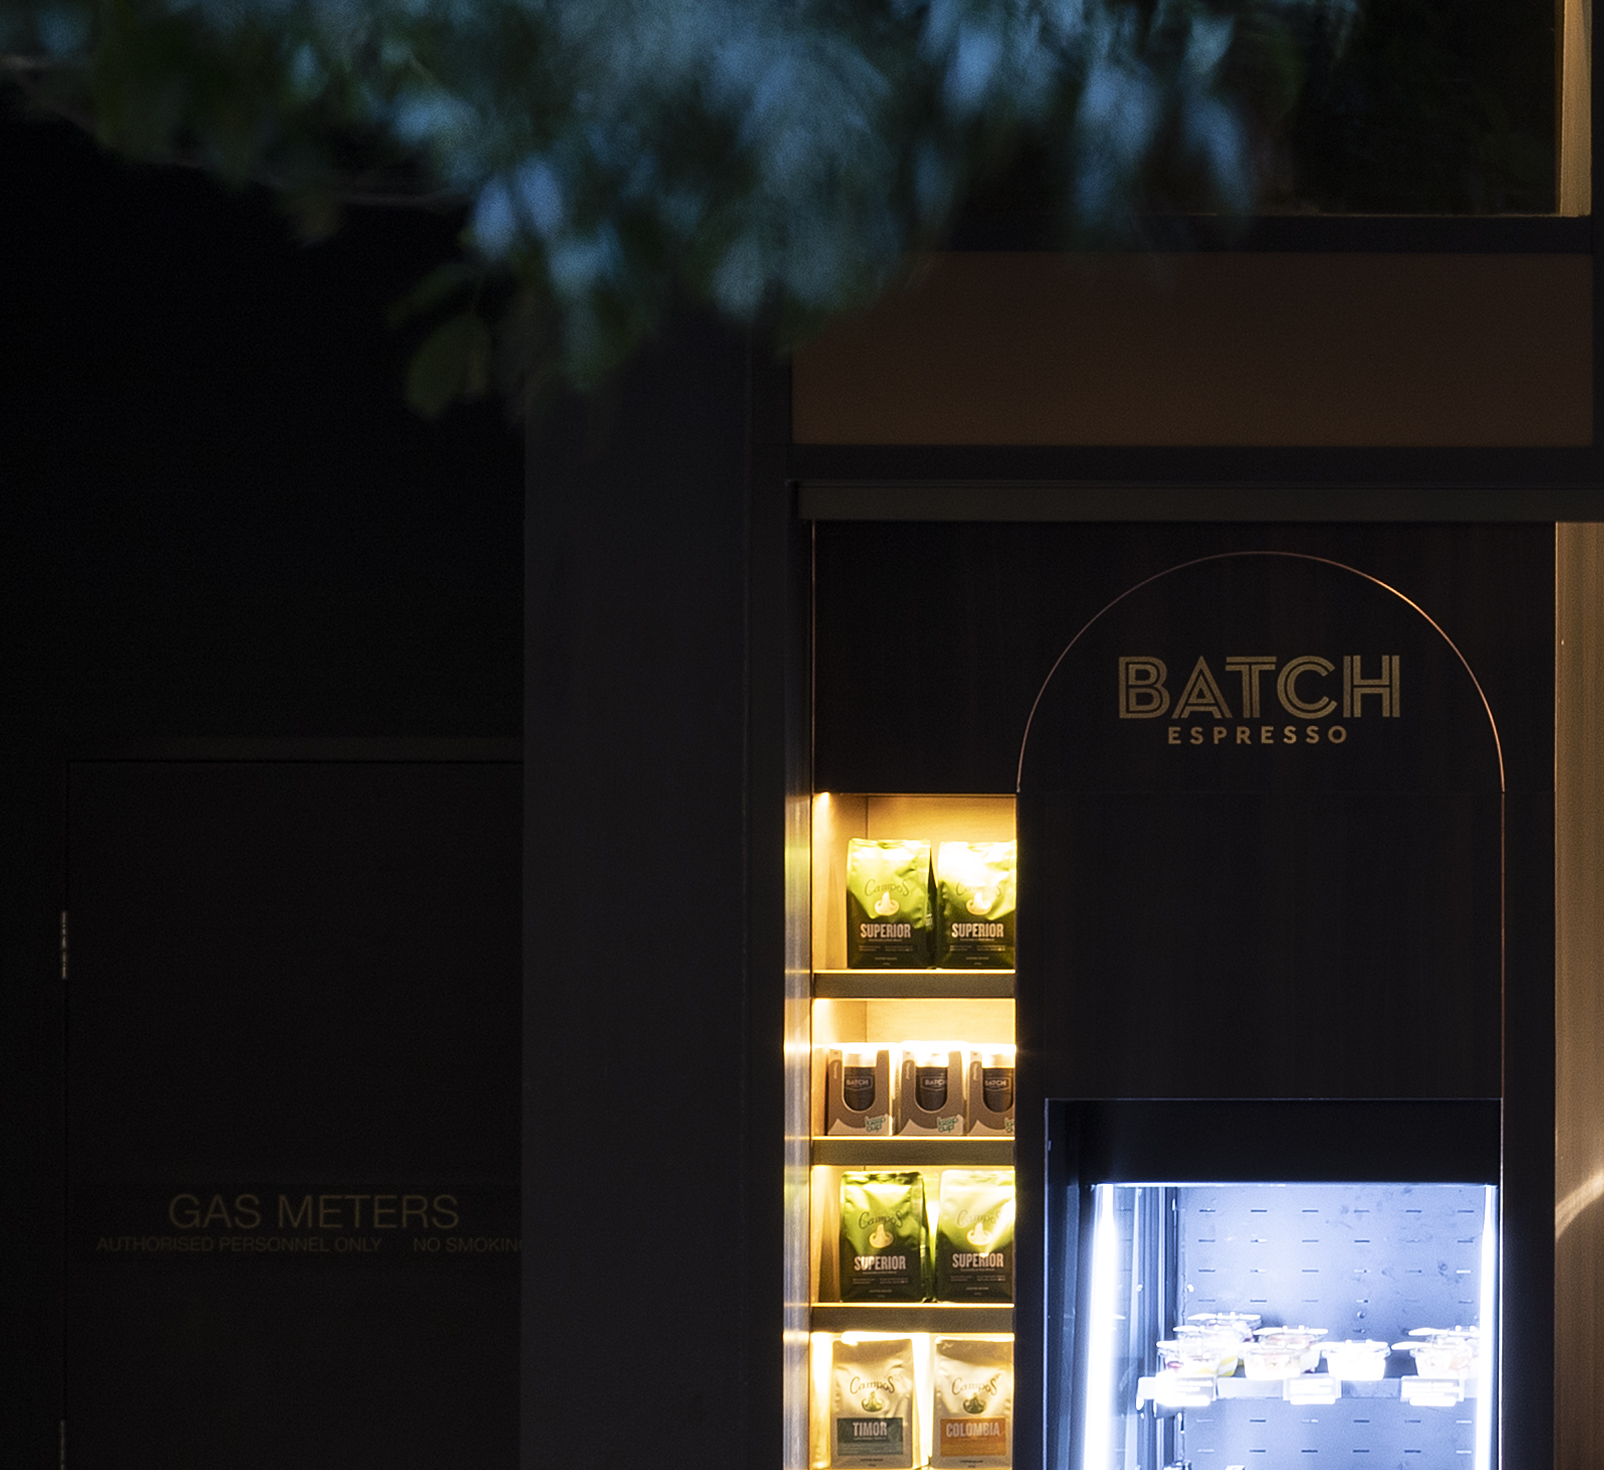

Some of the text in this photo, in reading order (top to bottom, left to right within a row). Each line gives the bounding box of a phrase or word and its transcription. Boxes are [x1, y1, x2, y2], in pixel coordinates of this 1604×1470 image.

[1118, 655, 1401, 719] BATCH
[1167, 725, 1349, 746] ESPRESSO
[860, 924, 911, 939] SUPERIOR
[951, 923, 1004, 939] SUPERIOR
[169, 1193, 460, 1229] GAS METERS
[97, 1236, 382, 1253] AUTHORISED PERSONNEL ONLY
[413, 1236, 521, 1253] NO SMOKIN
[854, 1255, 907, 1272] SUPERIOR
[952, 1253, 1004, 1269] SUPERIOR
[853, 1422, 888, 1437] TIMOR
[946, 1422, 1000, 1438] COLOMBIA
